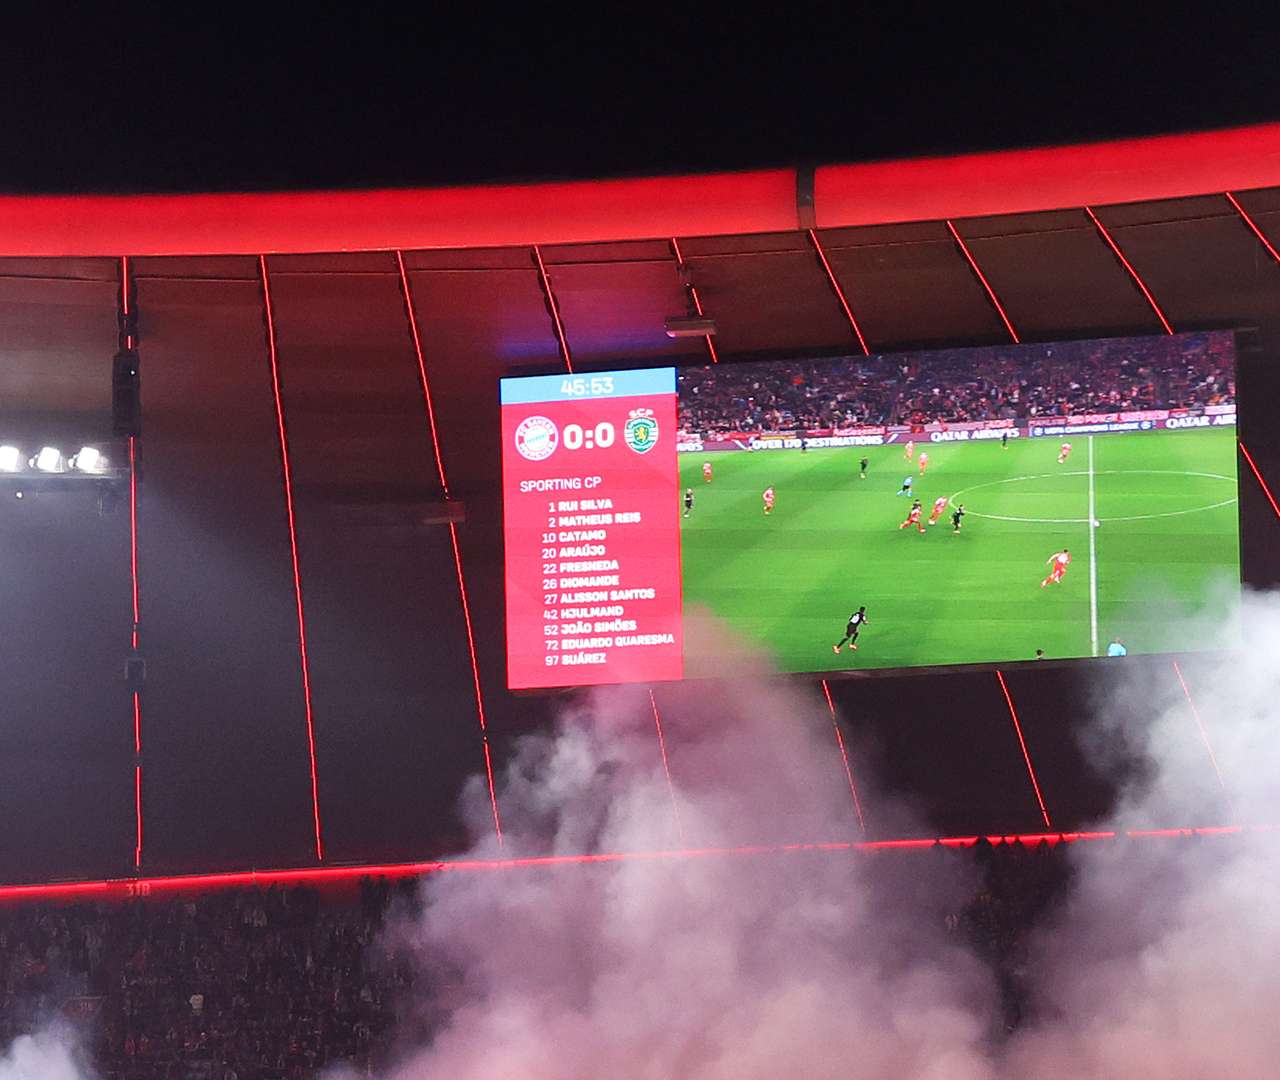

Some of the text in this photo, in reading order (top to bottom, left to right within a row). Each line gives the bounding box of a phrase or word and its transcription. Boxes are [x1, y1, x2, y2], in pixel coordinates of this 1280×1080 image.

[563, 422, 615, 449] 0:0
[520, 477, 601, 492] SPORTING CP
[549, 499, 612, 512] 1 RUI SILVA
[549, 512, 641, 527] 2 MATHEUS REIS
[542, 530, 606, 543] 10 CATAMO
[542, 545, 605, 559] 20 ARAÚJO
[543, 560, 619, 574] 22 FRESNEDA
[543, 575, 619, 590] 26 DIOMANDE
[545, 589, 655, 604] 27 ALISSON SANTOS
[544, 605, 624, 620] 42 HJULMAND
[544, 625, 558, 635] 52
[545, 634, 674, 651] 72 EDUARDO QUARESMA
[545, 653, 606, 666] 97 SUÁREZ
